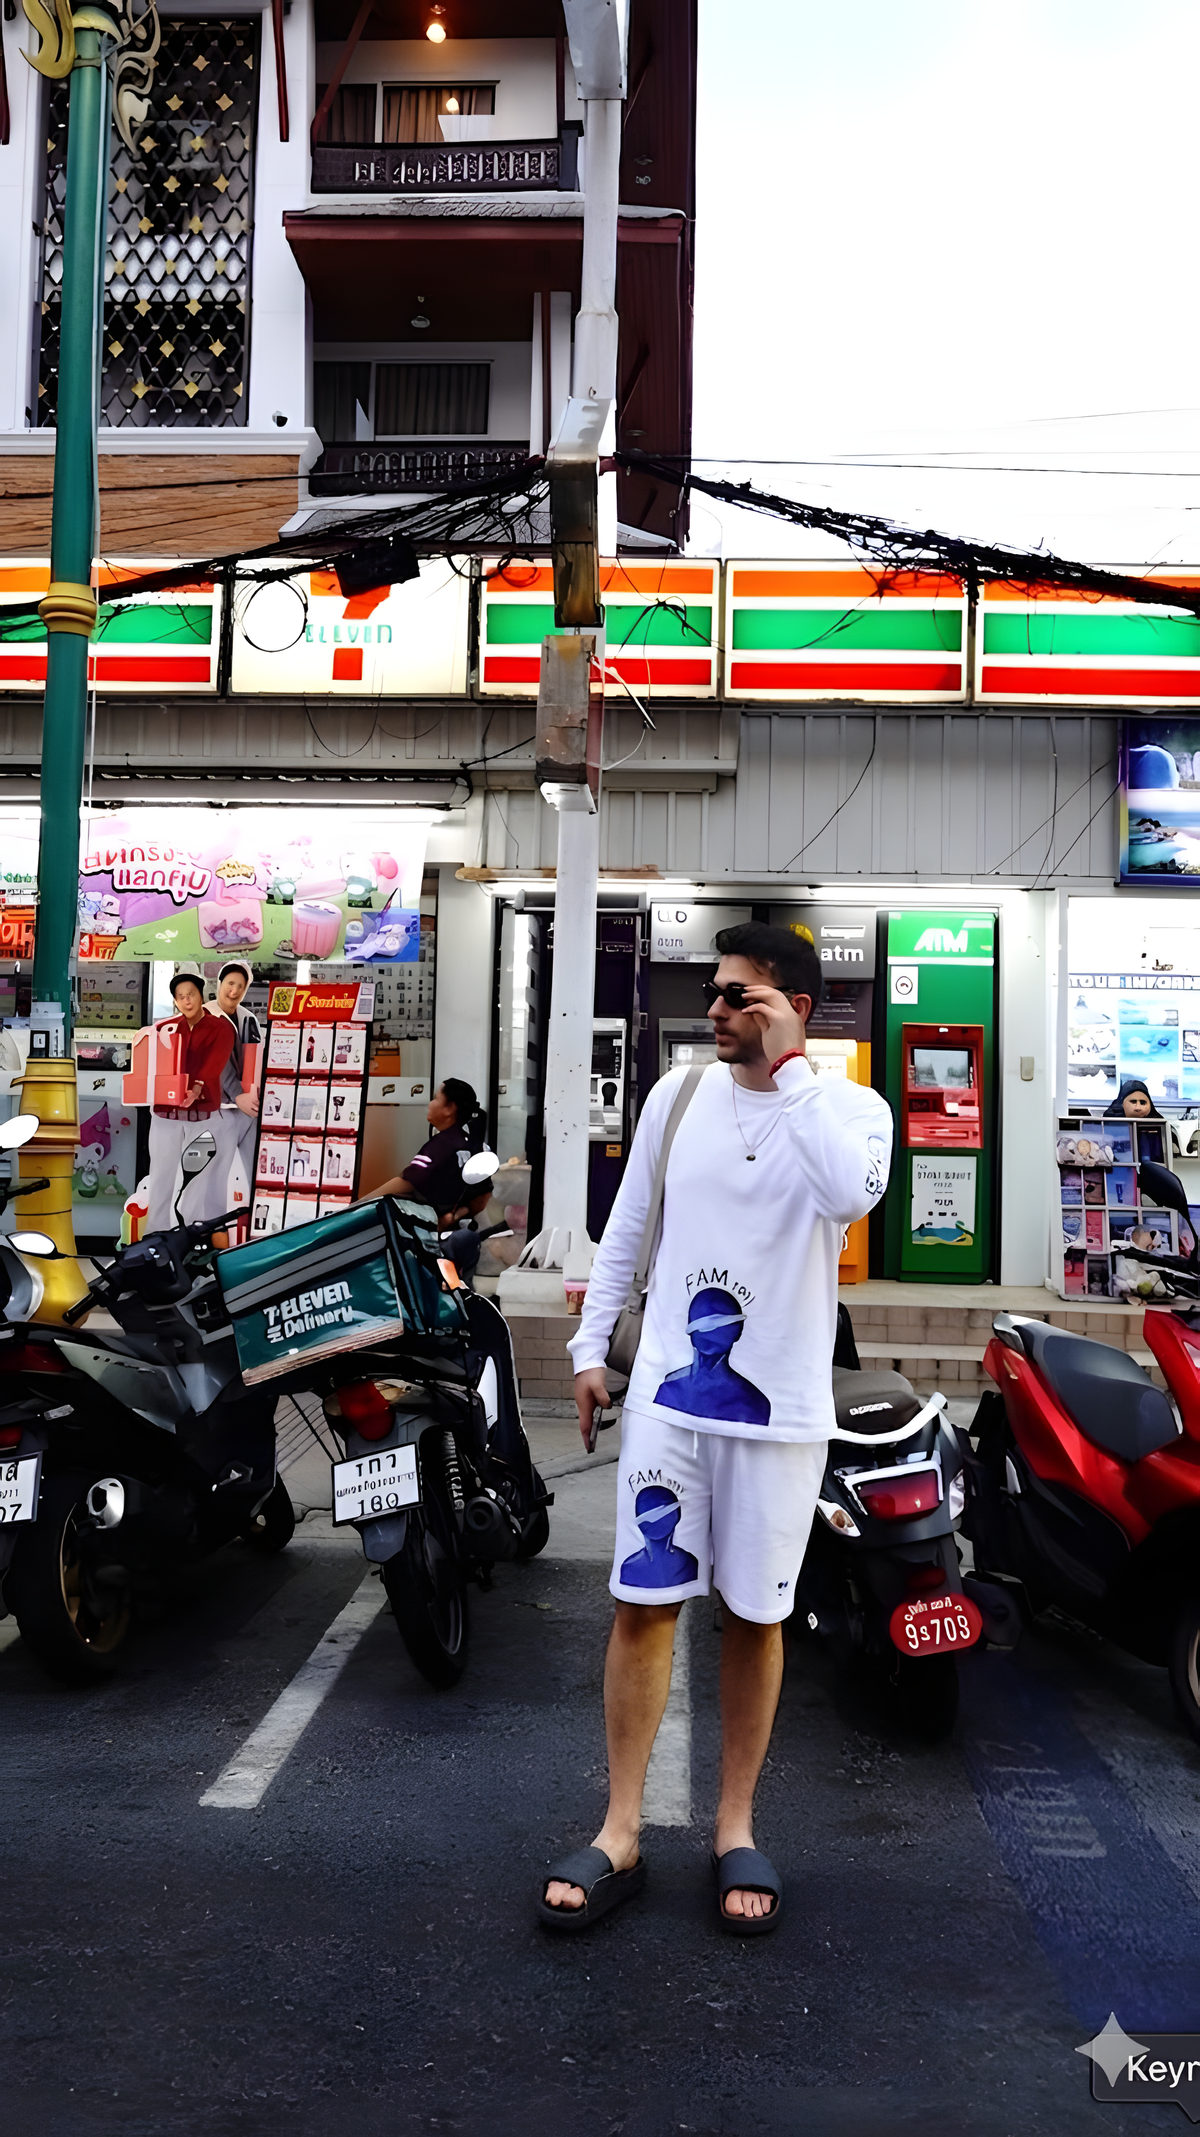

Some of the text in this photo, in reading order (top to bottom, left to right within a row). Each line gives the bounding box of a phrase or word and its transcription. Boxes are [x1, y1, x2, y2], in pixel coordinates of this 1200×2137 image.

[821, 945, 864, 961] atm
[914, 928, 968, 953] ATM
[685, 1267, 729, 1297] FAM
[628, 1469, 662, 1494] FAM
